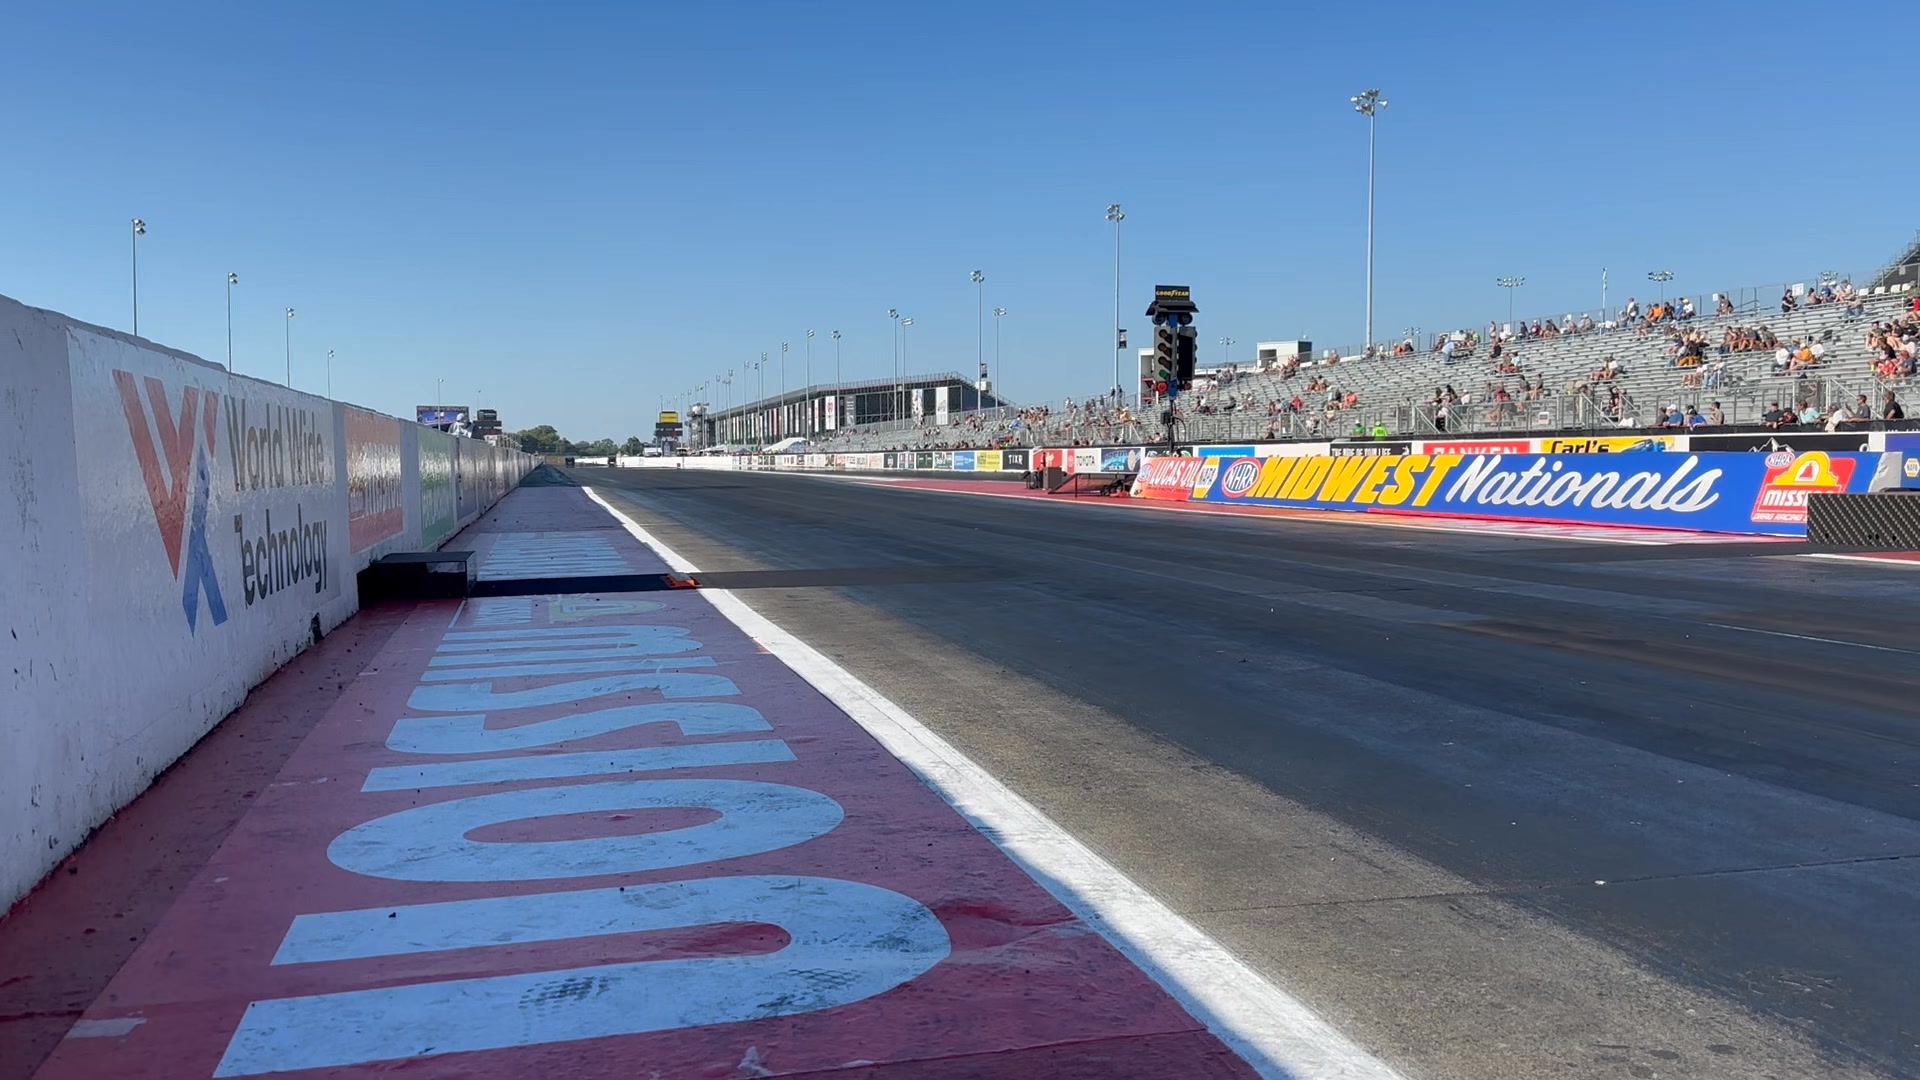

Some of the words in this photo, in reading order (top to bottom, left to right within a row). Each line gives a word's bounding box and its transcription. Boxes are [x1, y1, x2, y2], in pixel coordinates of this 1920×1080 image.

[224, 394, 284, 491] World
[285, 407, 325, 485] Wide
[1551, 440, 1609, 454] Carl's
[1008, 455, 1023, 465] TIXR
[1076, 455, 1095, 466] TOYOTA
[1149, 460, 1184, 486] LUCAS
[1180, 460, 1203, 488] OIL
[1769, 454, 1791, 466] NHRA
[1226, 463, 1257, 491] NHRA
[1245, 454, 1465, 507] MIDWEST
[1445, 454, 1723, 512] Nationals
[234, 503, 327, 608] Technology
[214, 624, 951, 1078] MISSION
